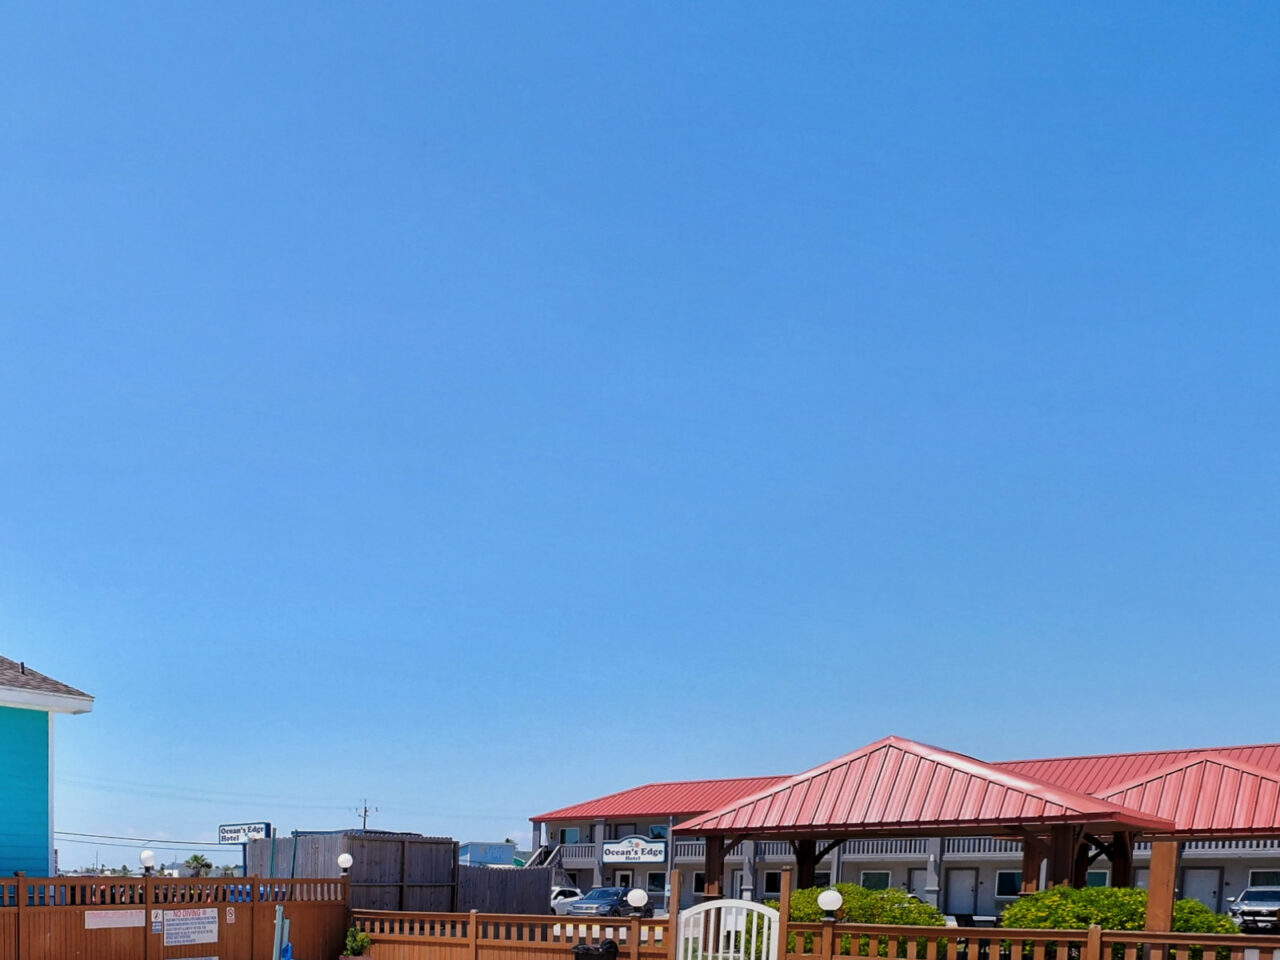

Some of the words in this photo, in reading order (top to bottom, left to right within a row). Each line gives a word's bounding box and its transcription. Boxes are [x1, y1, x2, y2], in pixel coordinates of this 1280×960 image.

[604, 848, 639, 856] Ocean's
[640, 847, 663, 857] Edge
[173, 910, 181, 918] NO
[182, 909, 200, 917] DIVING
